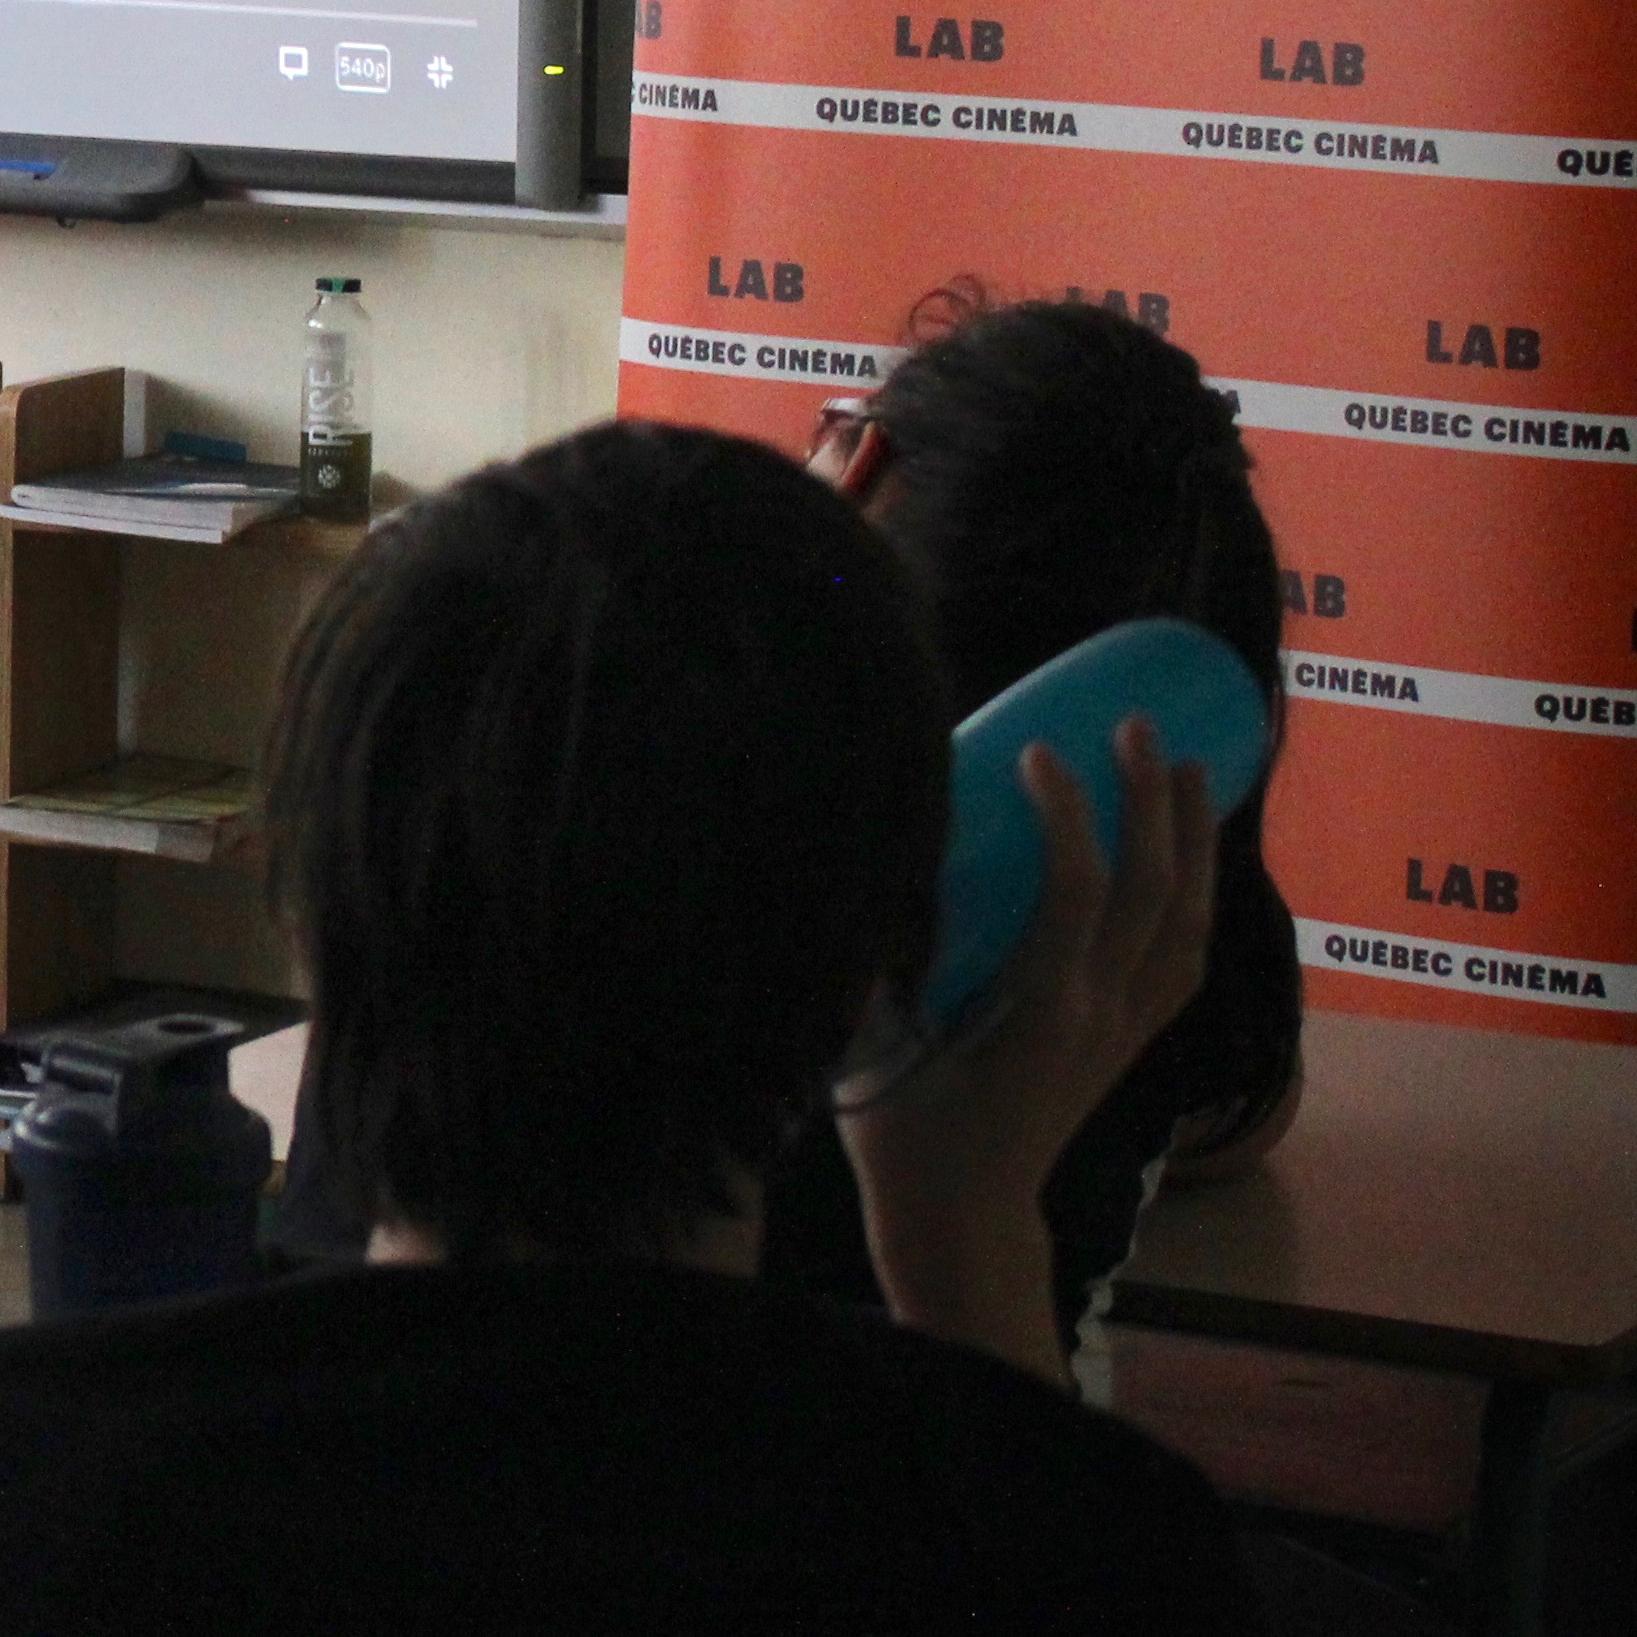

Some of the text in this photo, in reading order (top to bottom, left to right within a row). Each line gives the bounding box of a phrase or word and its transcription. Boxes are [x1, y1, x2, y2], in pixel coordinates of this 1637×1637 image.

[894, 15, 1004, 63] LAB
[1259, 38, 1365, 87] LAB
[340, 55, 386, 83] 540p
[641, 84, 718, 112] CINÉMA
[817, 98, 1077, 136] QUÉBEC CINÉMA
[1183, 122, 1439, 164] QUÉBEC CINÉMA
[707, 256, 804, 304] LAB
[649, 334, 877, 379] QUÉBEC CINÉMA
[1426, 321, 1542, 372] LAB
[1345, 403, 1632, 453] QUÉBEC CINÉMA
[1280, 569, 1347, 619] AB
[1295, 664, 1419, 702] CINÉMA
[1405, 858, 1519, 915] LAB
[1325, 935, 1607, 1000] QUÉBEC CINÉMA
